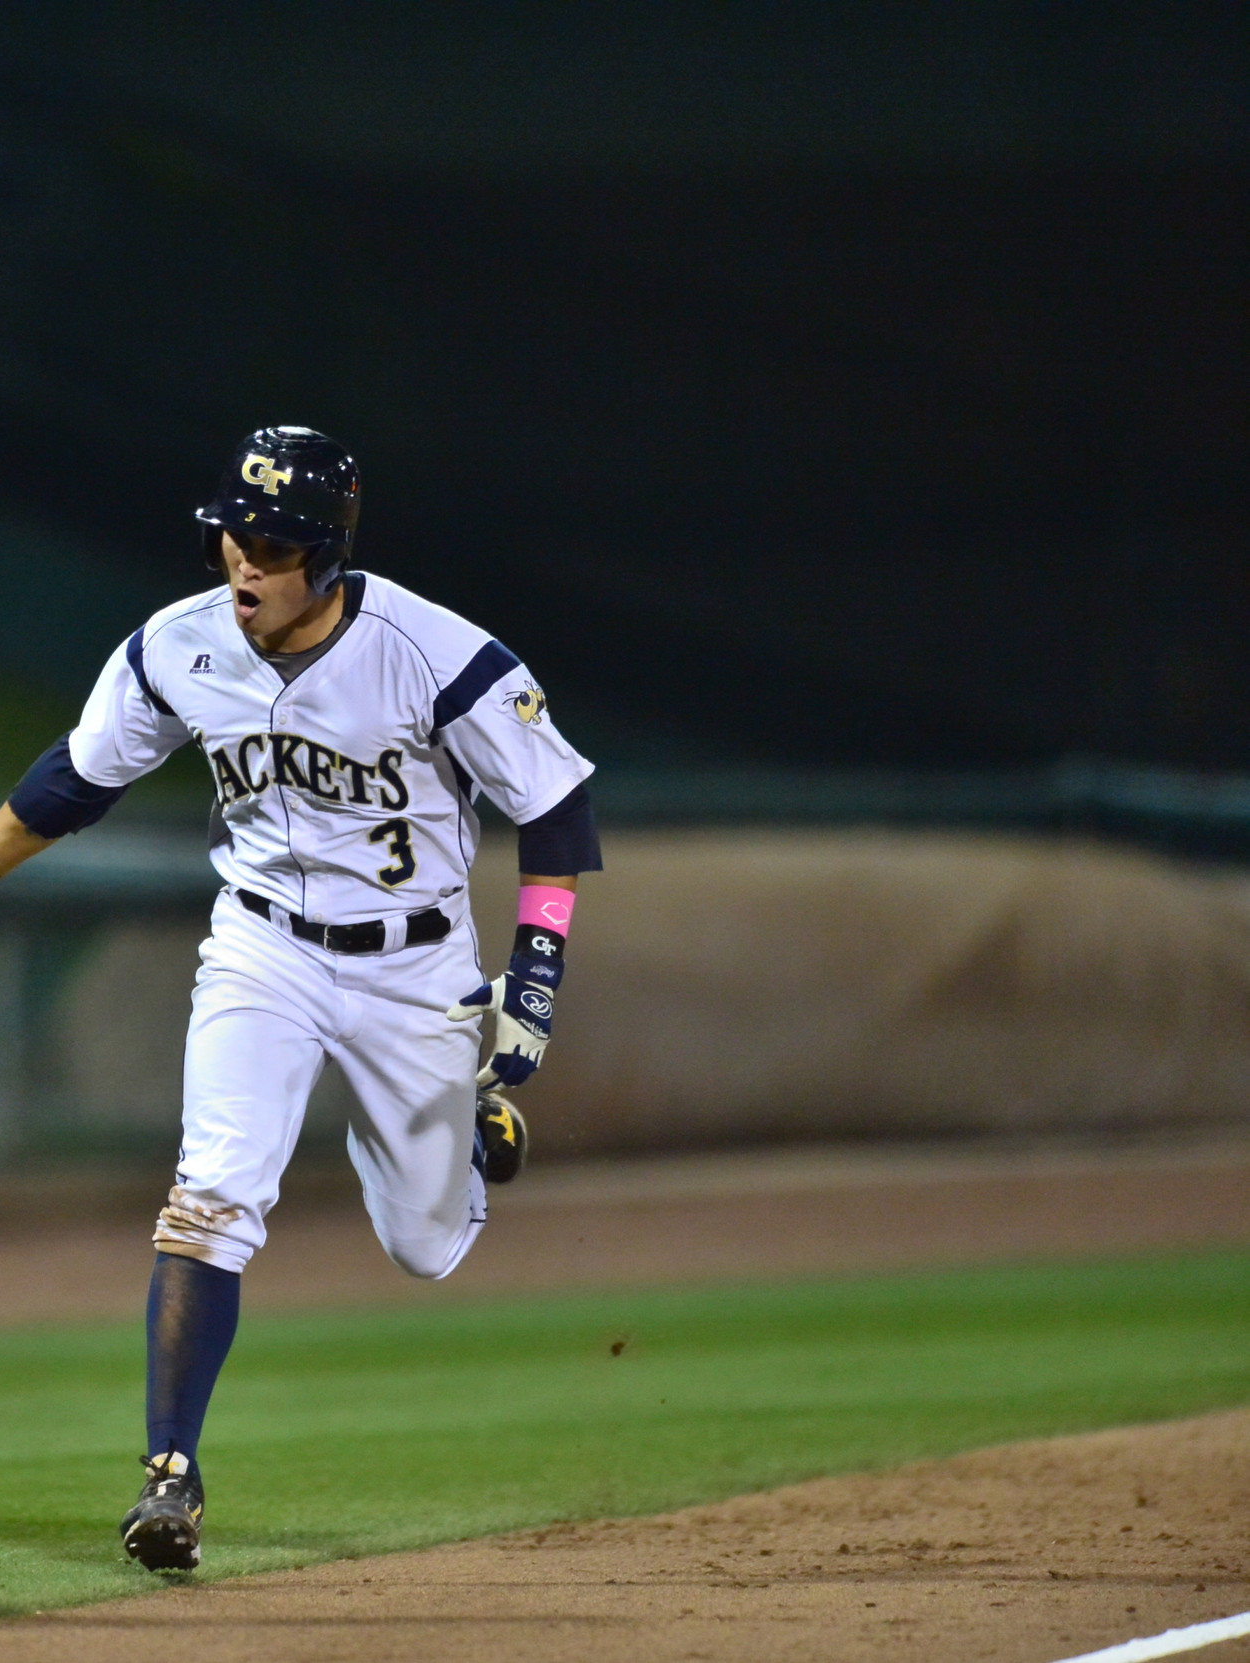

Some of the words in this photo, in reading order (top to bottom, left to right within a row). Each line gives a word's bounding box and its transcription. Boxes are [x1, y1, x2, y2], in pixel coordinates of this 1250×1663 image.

[241, 455, 292, 496] GT
[244, 512, 256, 522] 3
[192, 654, 211, 669] R
[367, 817, 419, 890] 3
